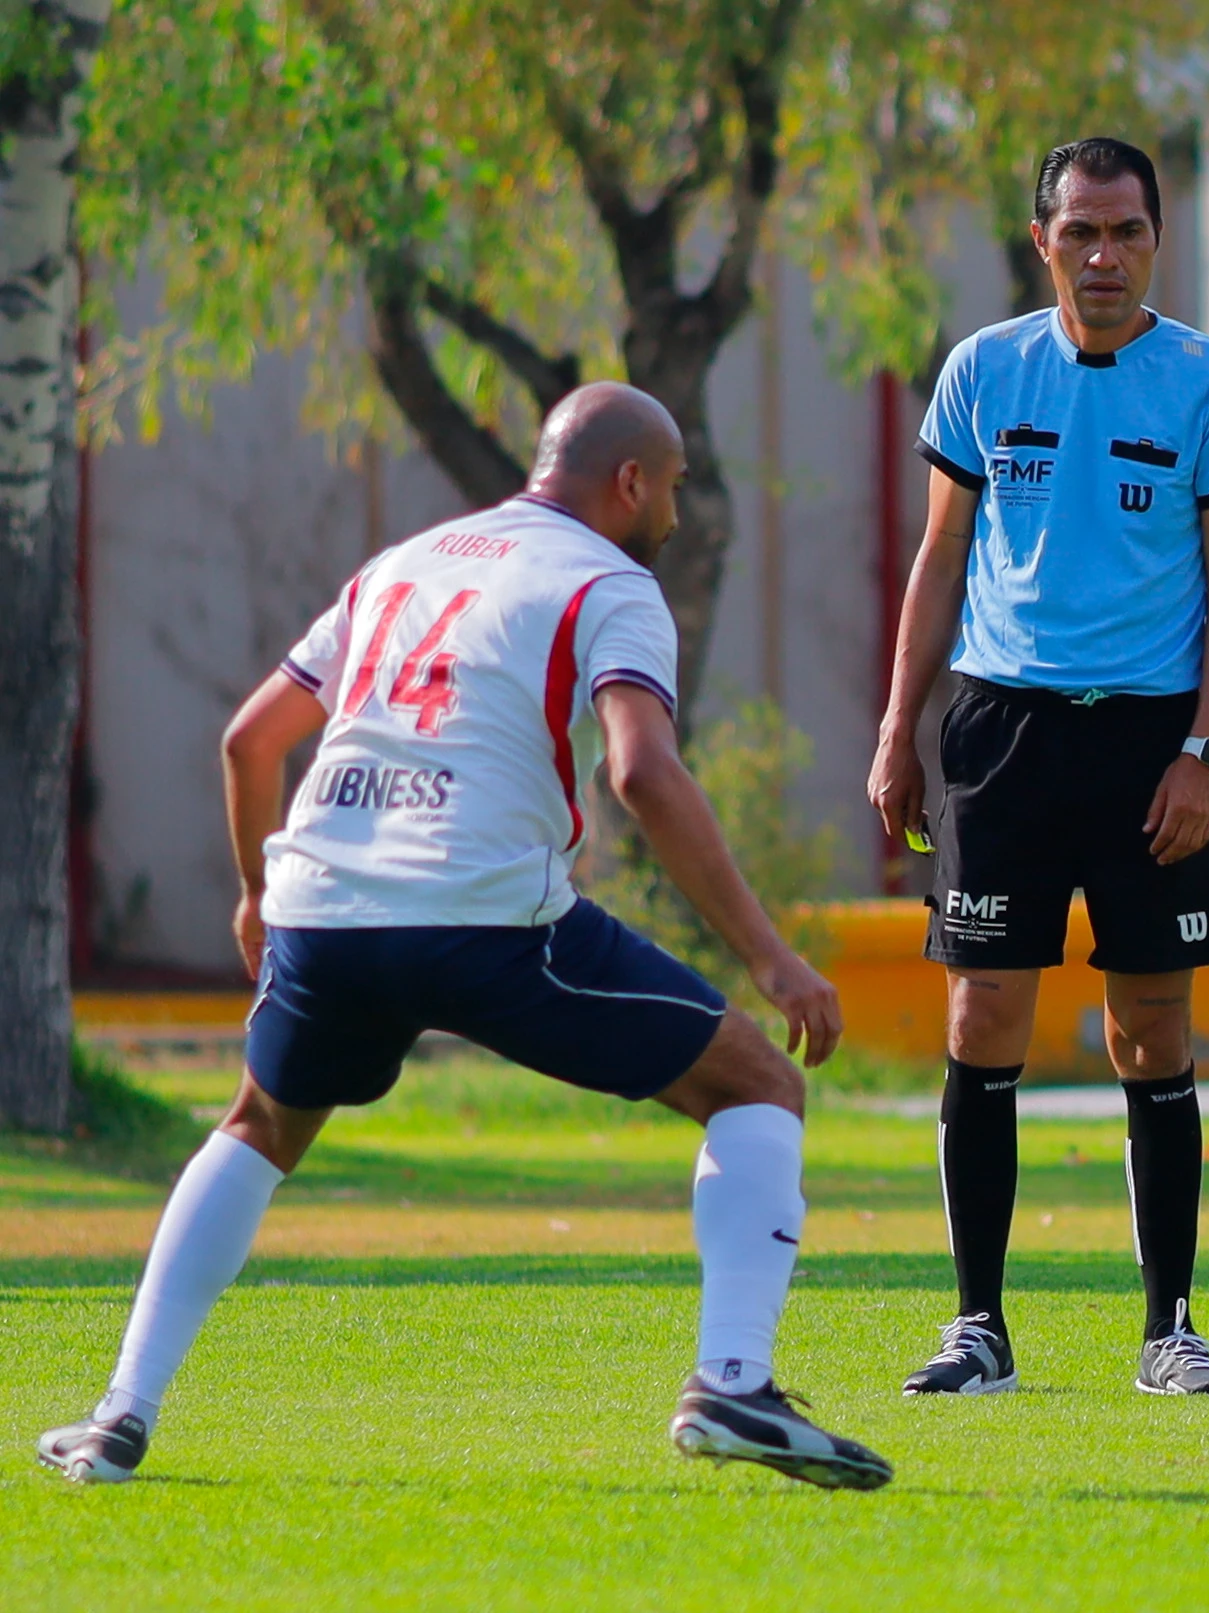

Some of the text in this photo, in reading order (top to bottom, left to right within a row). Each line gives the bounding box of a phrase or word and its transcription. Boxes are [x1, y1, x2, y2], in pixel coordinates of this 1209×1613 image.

[992, 458, 1055, 484] FMF
[429, 532, 521, 560] RUBEN
[341, 581, 481, 738] 14
[299, 766, 455, 810] UBNESS
[946, 889, 1009, 920] FMF
